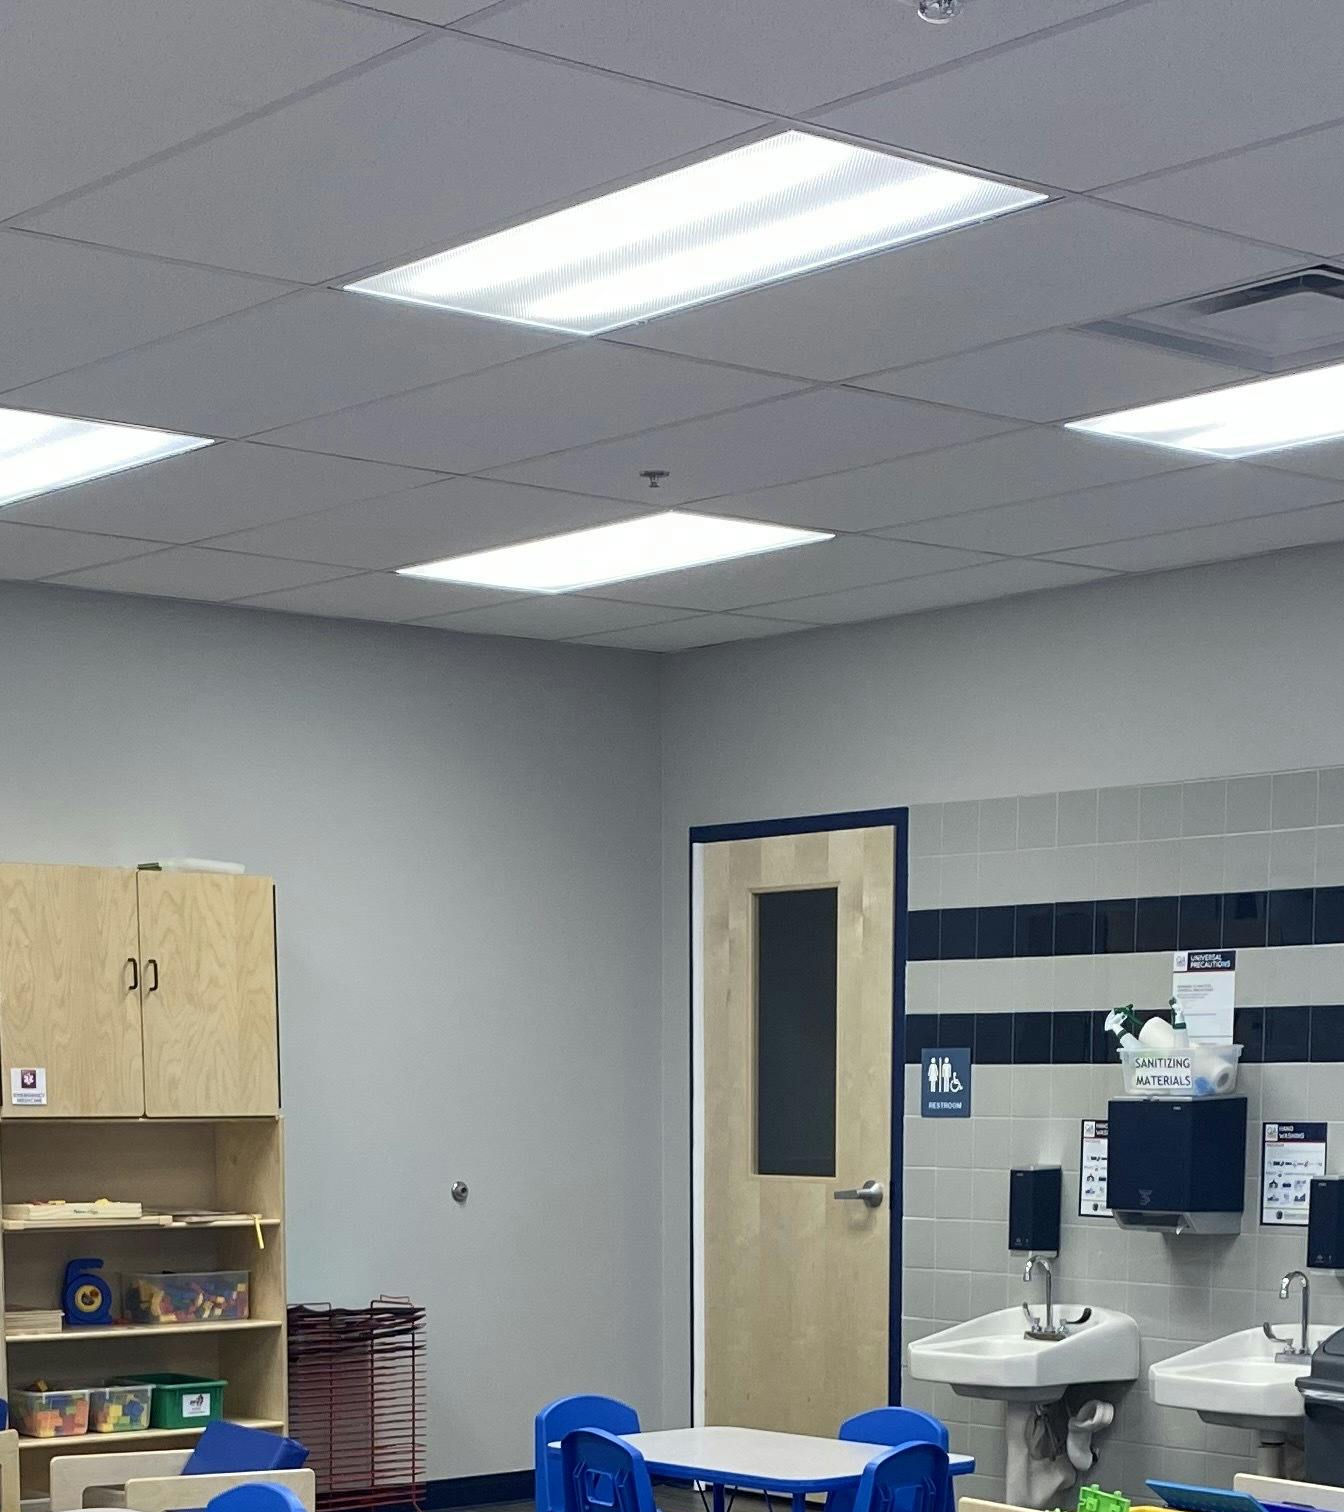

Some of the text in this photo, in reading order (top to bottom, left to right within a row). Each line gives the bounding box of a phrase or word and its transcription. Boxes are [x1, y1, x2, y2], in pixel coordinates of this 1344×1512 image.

[1190, 960, 1230, 968] PRECAUTIONS
[1136, 1058, 1190, 1068] SANITIZING
[1136, 1076, 1191, 1086] MATERIALS
